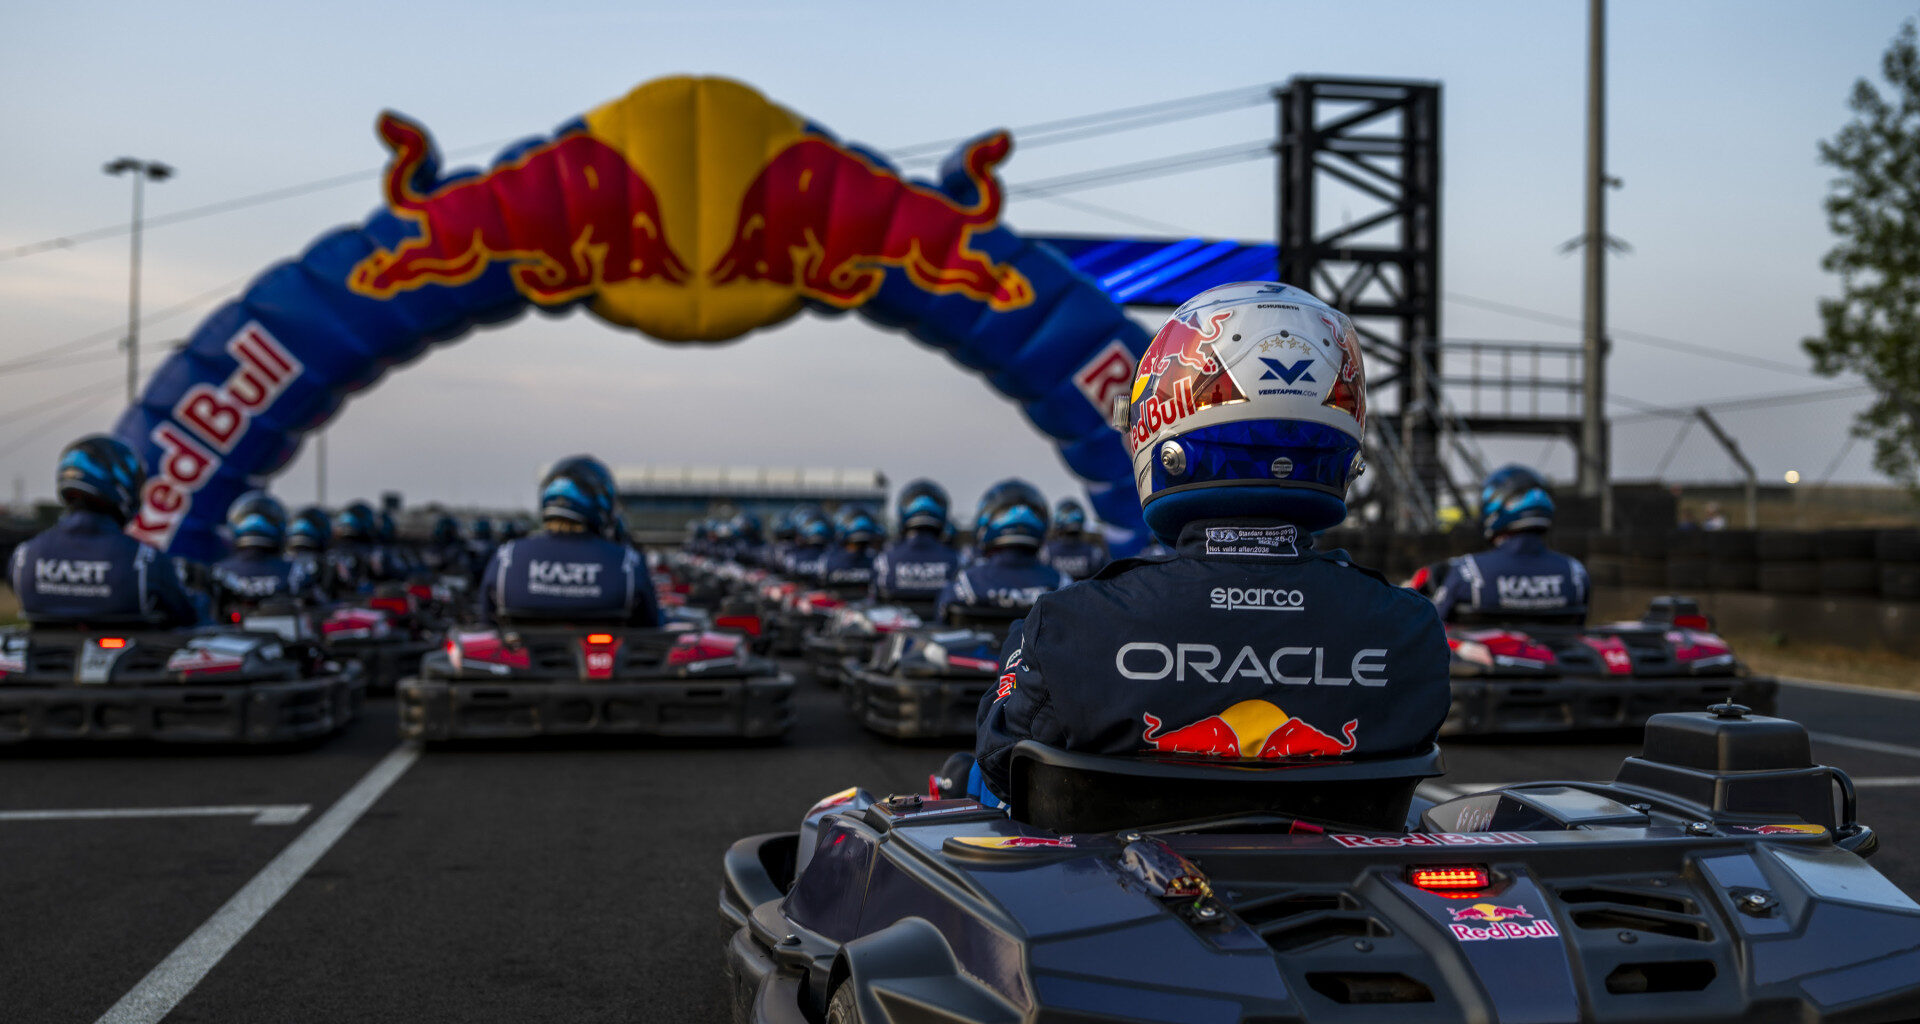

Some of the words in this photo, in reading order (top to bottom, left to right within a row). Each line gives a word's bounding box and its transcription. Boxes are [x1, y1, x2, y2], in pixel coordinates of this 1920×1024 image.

[1257, 304, 1300, 312] SCHUBERTH
[179, 325, 297, 447] Bull
[1258, 388, 1318, 398] VERSTAPPEN.COM
[1130, 400, 1151, 454] ed
[1145, 379, 1196, 434] Bull
[37, 559, 111, 584] KART
[529, 560, 602, 585] KART
[1497, 575, 1564, 597] KART
[1210, 588, 1304, 610] sparco
[1116, 642, 1388, 687] ORACLE
[1331, 833, 1436, 847] Red
[1434, 832, 1537, 845] Bull
[1450, 922, 1507, 940] Red
[1503, 920, 1558, 938] Bull
